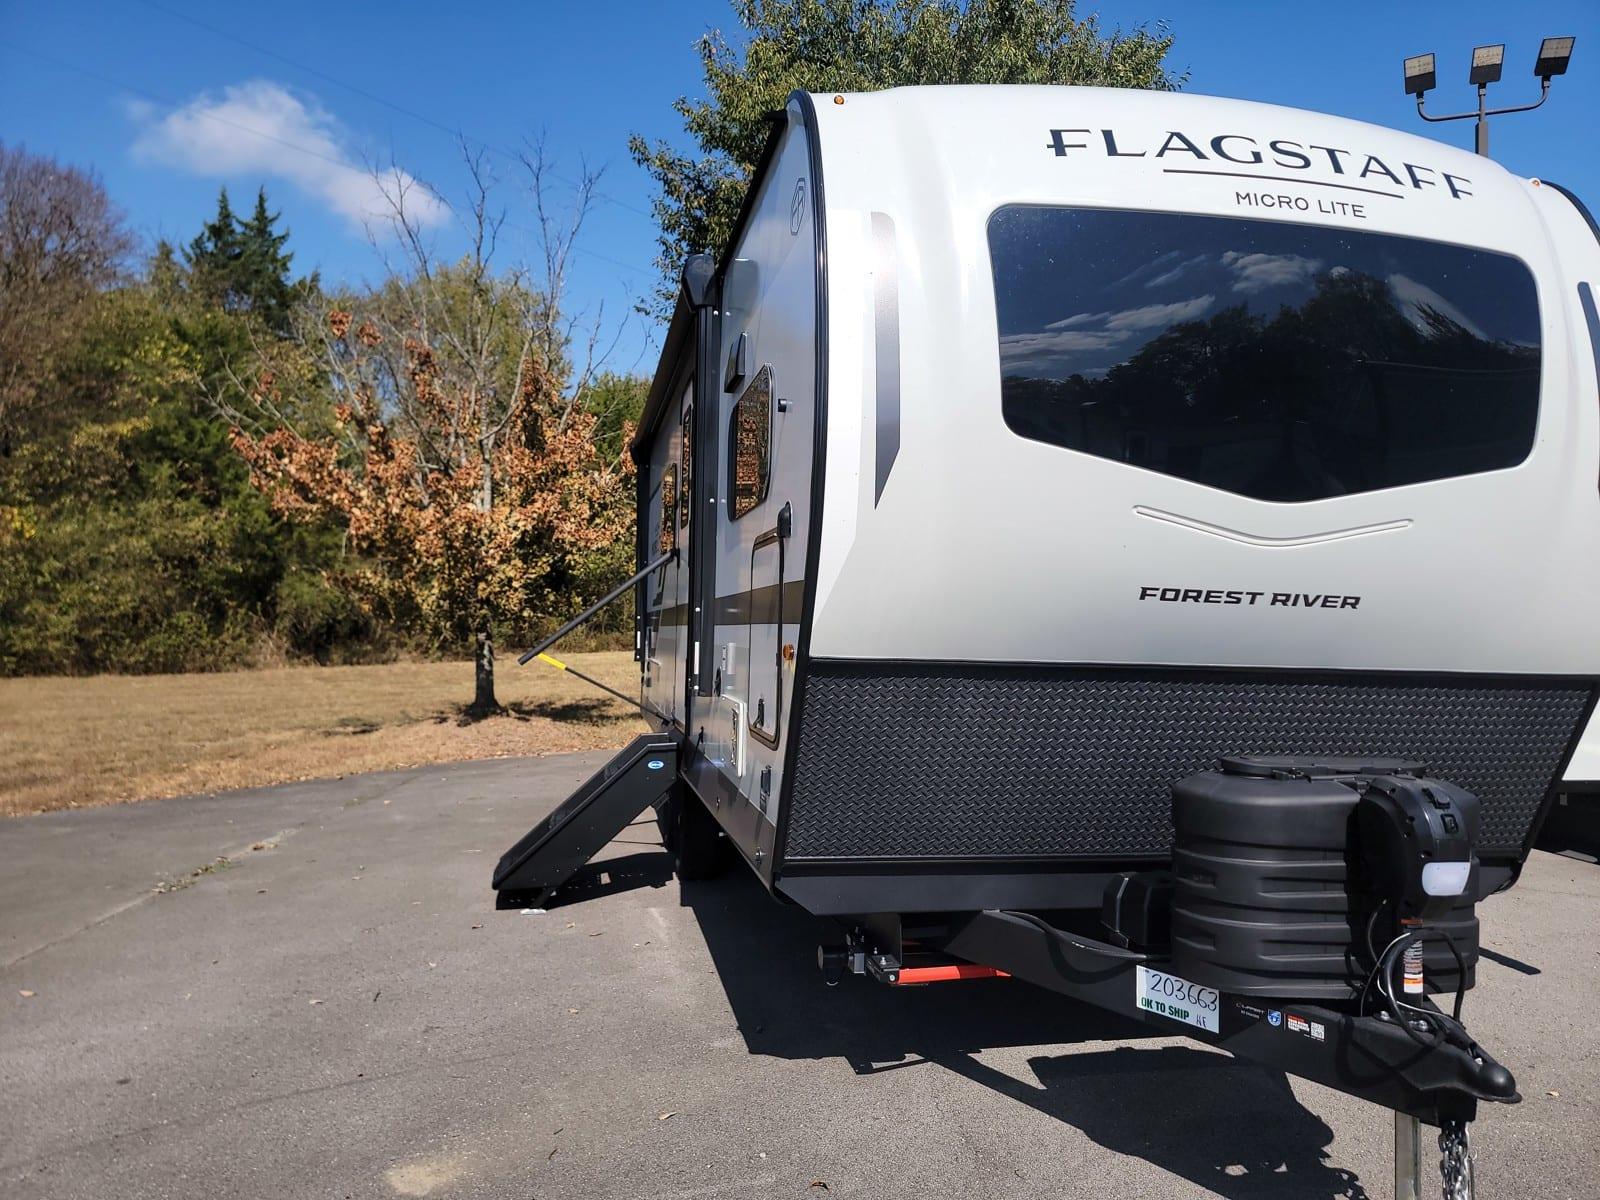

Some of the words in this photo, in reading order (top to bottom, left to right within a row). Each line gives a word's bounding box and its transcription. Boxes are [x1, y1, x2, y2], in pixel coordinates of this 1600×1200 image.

[1046, 128, 1473, 200] FLAGSTAFF
[1235, 191, 1310, 212] MICRO
[1317, 200, 1367, 219] LITE
[1139, 586, 1265, 605] FOREST
[1270, 592, 1361, 610] RIVER
[1150, 973, 1218, 1012] 203663
[1141, 996, 1153, 1010] OK
[1154, 1001, 1166, 1013] TO
[1168, 1005, 1190, 1020] SHIP
